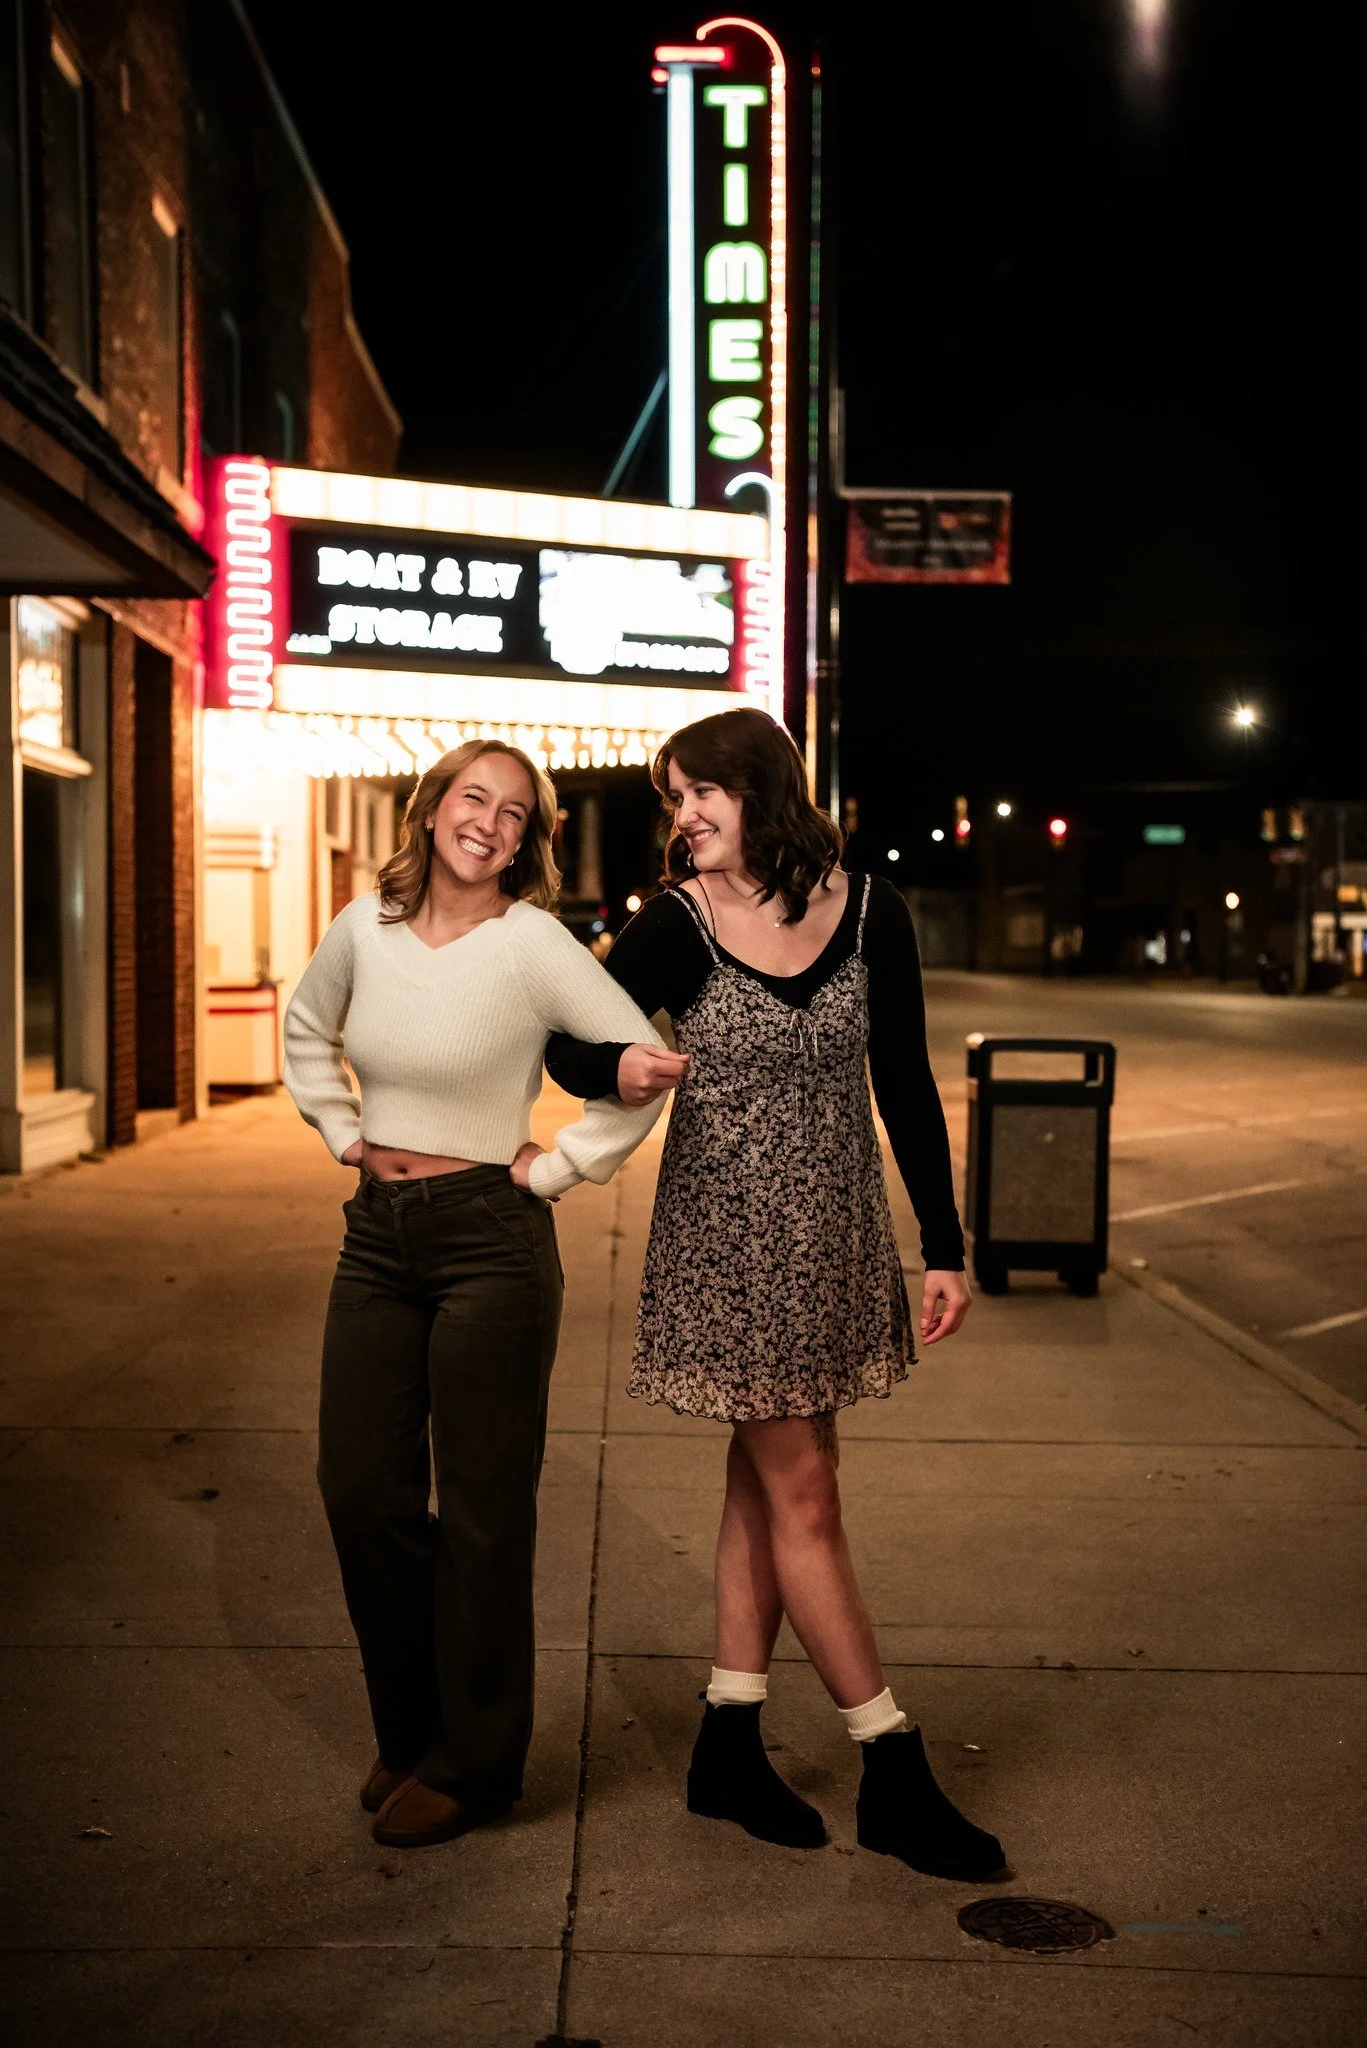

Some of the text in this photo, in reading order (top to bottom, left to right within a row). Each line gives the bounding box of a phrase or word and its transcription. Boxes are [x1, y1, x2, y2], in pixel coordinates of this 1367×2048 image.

[704, 85, 768, 460] TIMES
[317, 546, 426, 592] BOAT
[431, 557, 464, 595] &
